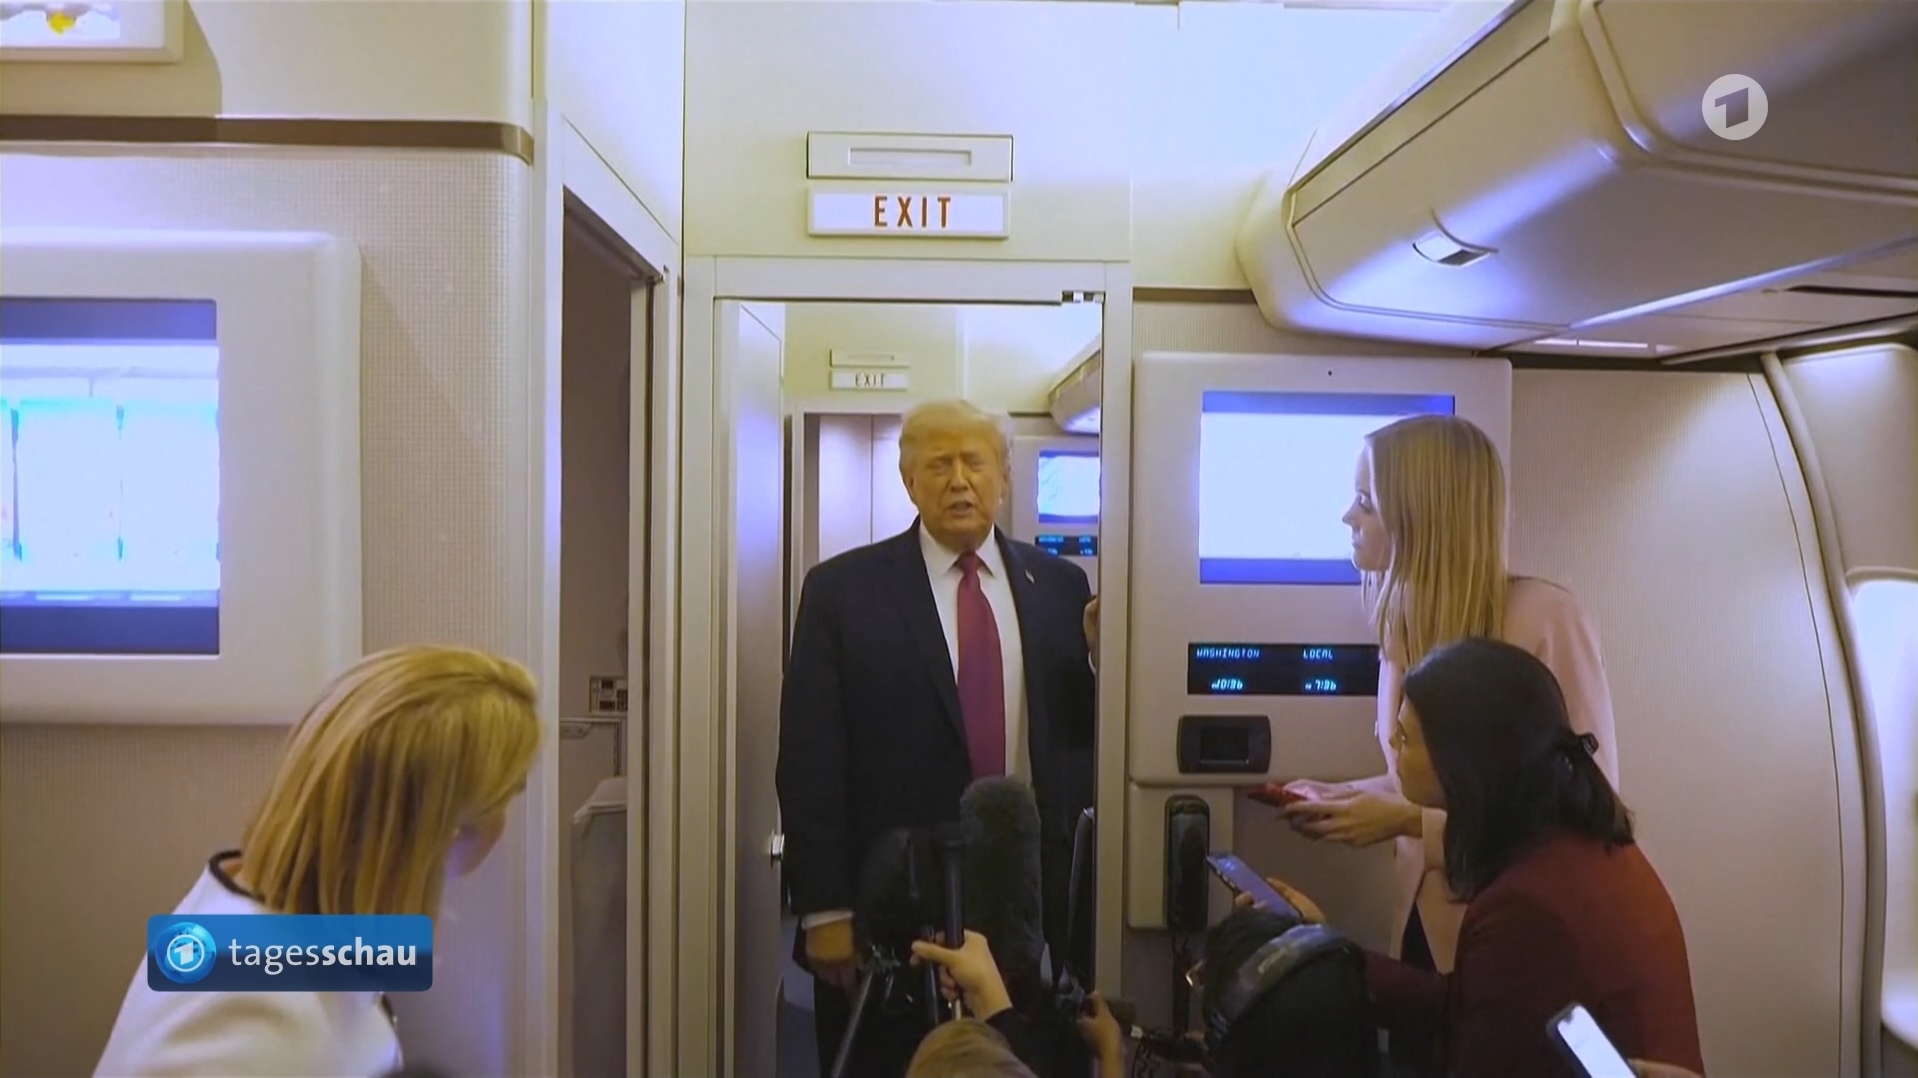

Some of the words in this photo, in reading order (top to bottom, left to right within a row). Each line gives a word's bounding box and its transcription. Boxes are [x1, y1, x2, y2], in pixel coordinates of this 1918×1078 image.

[874, 195, 952, 228] EXIT
[855, 373, 885, 387] EXIT
[1196, 647, 1260, 659] WASHINGTON
[1303, 648, 1333, 660] LOCAL
